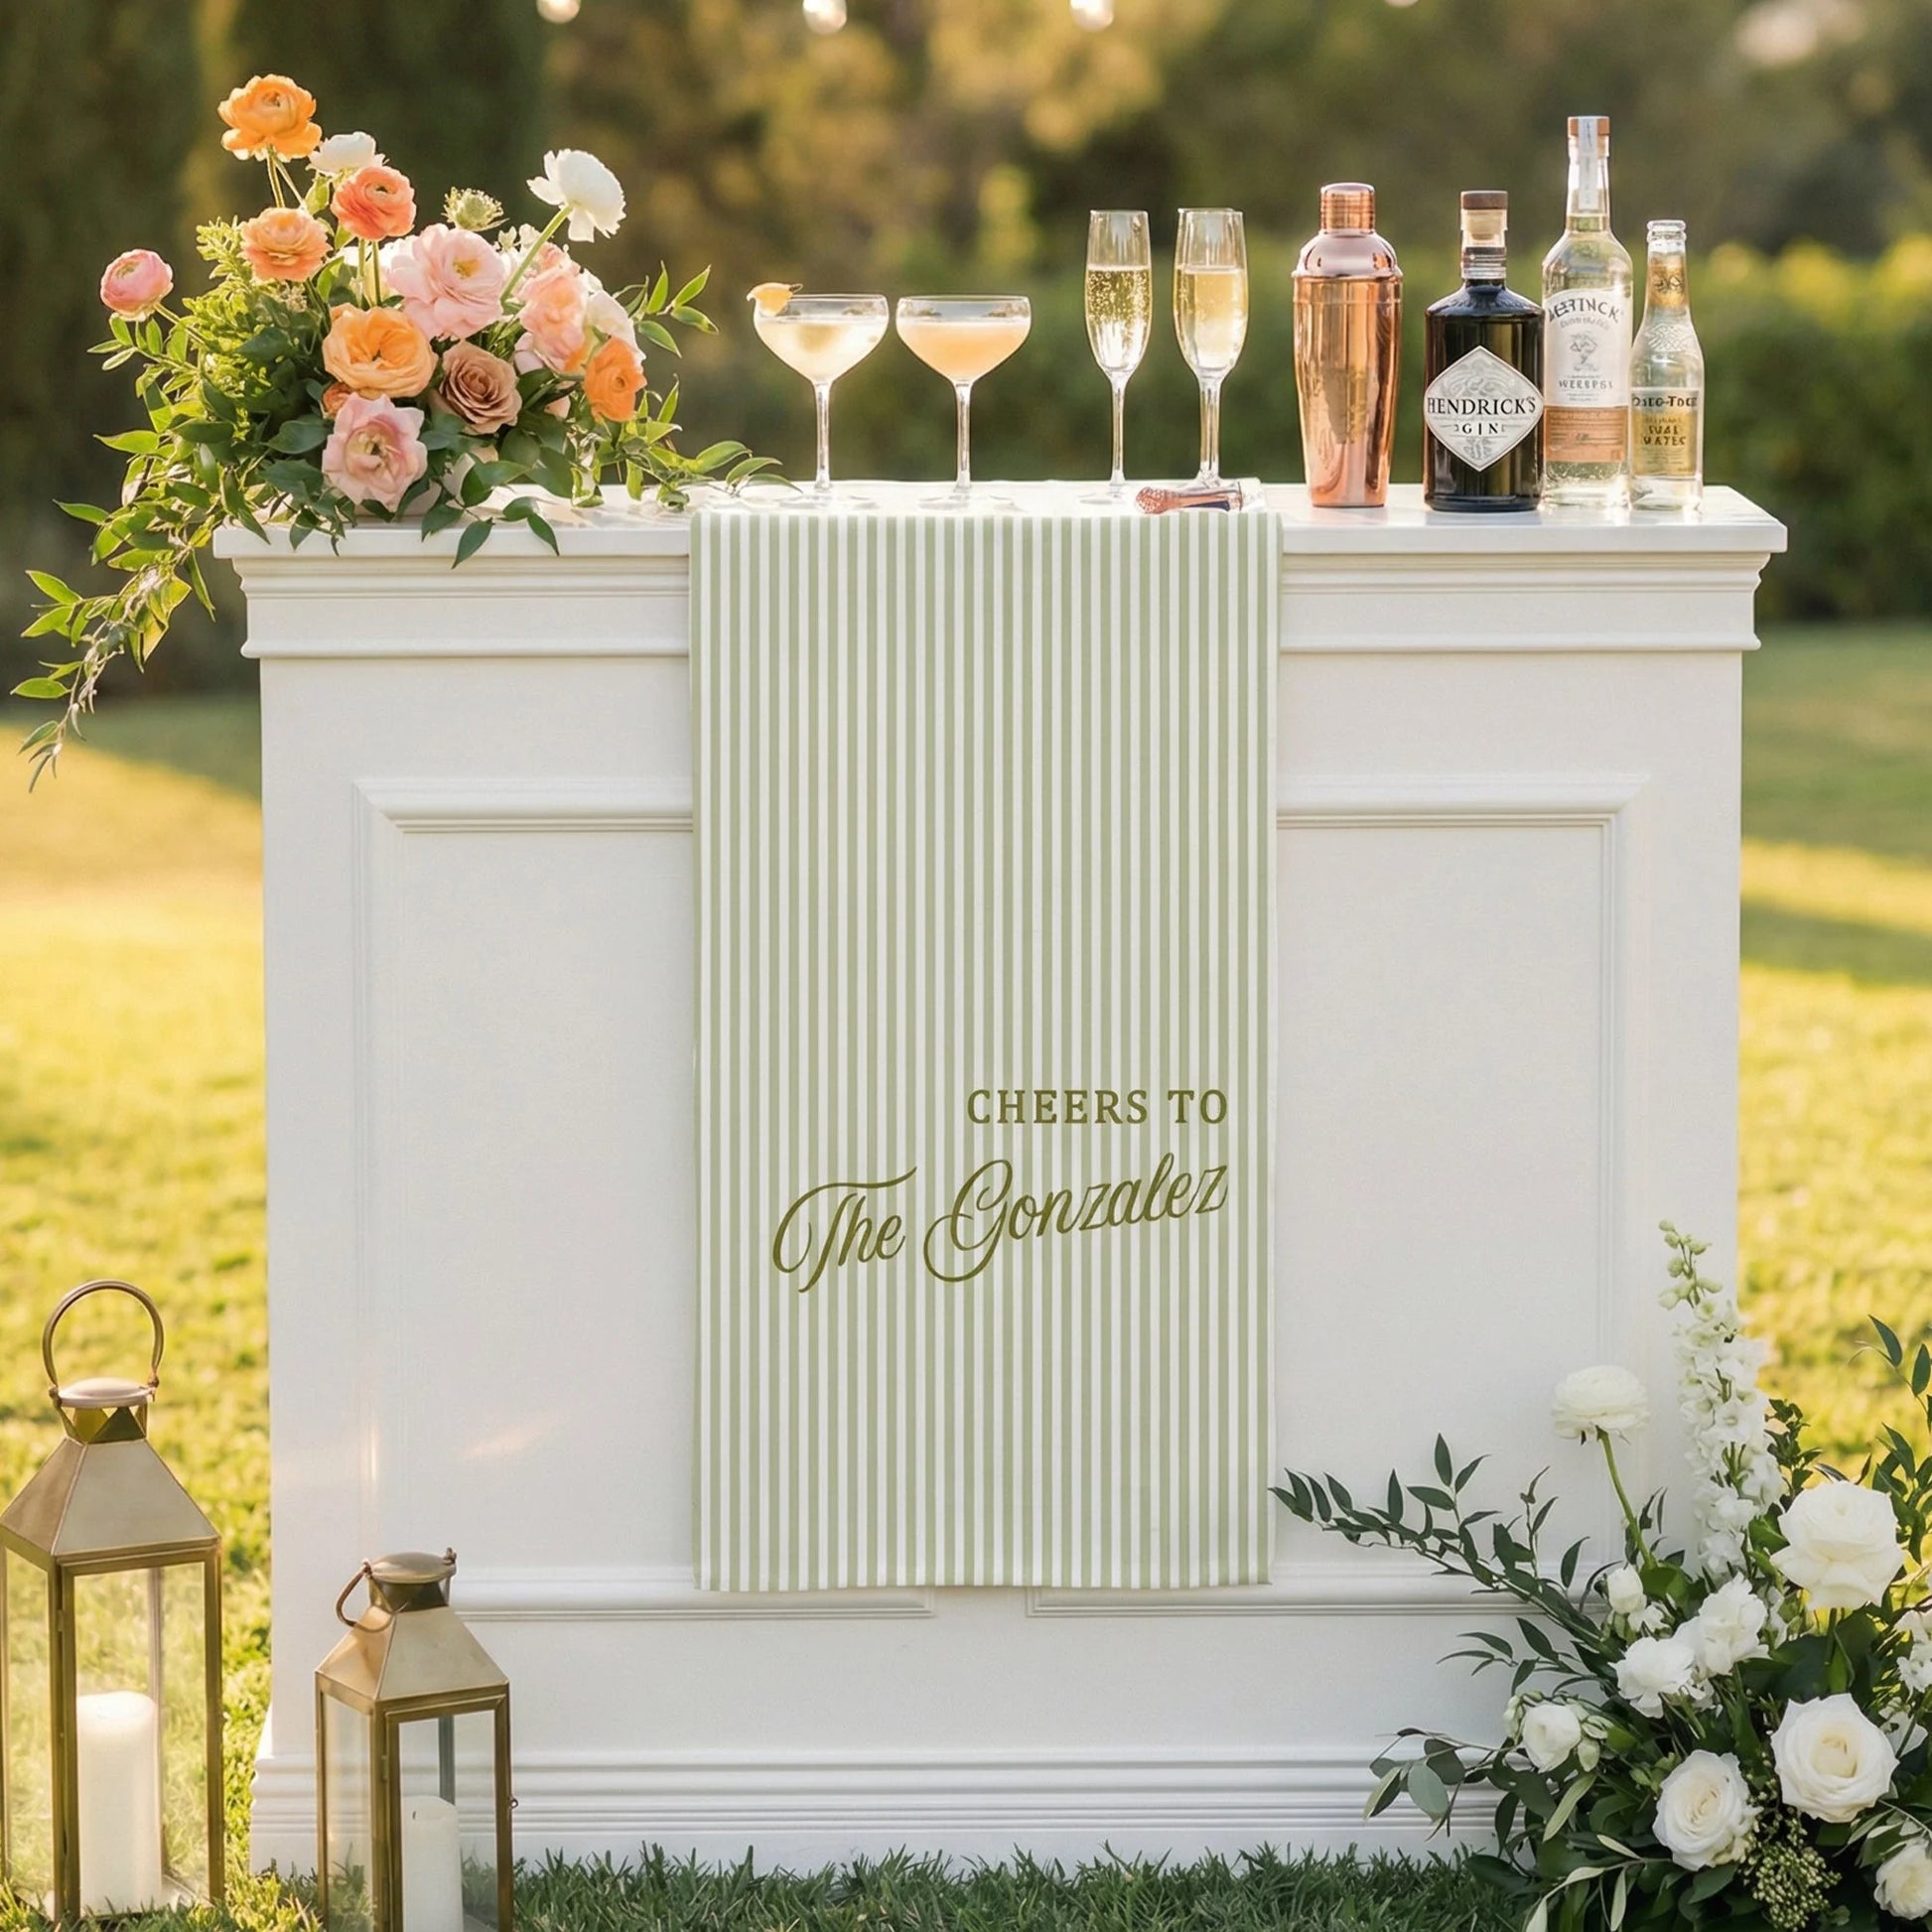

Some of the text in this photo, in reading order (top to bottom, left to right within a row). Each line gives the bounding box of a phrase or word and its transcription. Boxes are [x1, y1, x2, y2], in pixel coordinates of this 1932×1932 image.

[1427, 397, 1537, 416] HENDRICK'S
[1461, 422, 1499, 436] GIN
[967, 1089, 1228, 1124] CHEERS TO
[772, 1152, 1228, 1294] The Gonzalez
